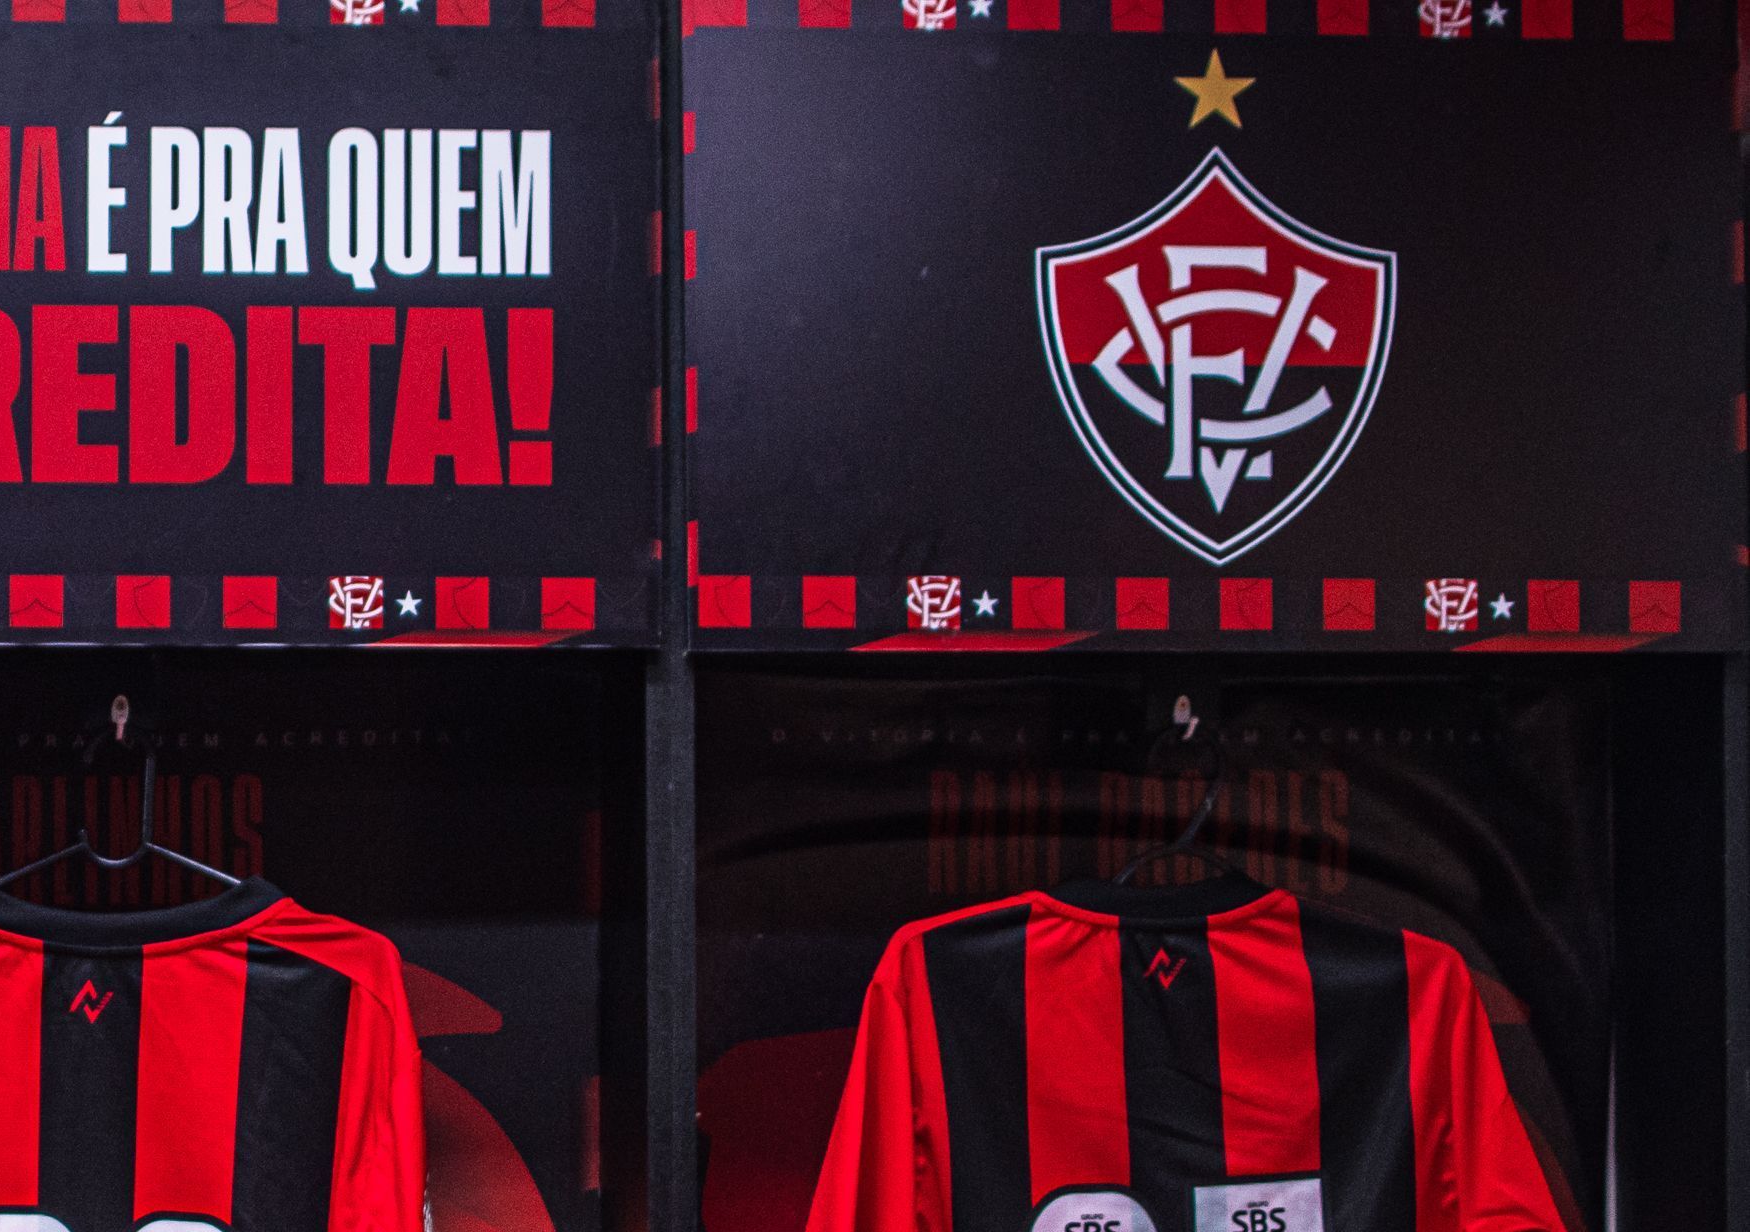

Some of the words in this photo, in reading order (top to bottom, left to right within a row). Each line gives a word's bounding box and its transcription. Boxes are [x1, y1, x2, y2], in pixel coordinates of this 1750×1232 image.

[87, 111, 128, 273] É
[150, 126, 309, 274] PRA
[327, 126, 553, 290] QUEM
